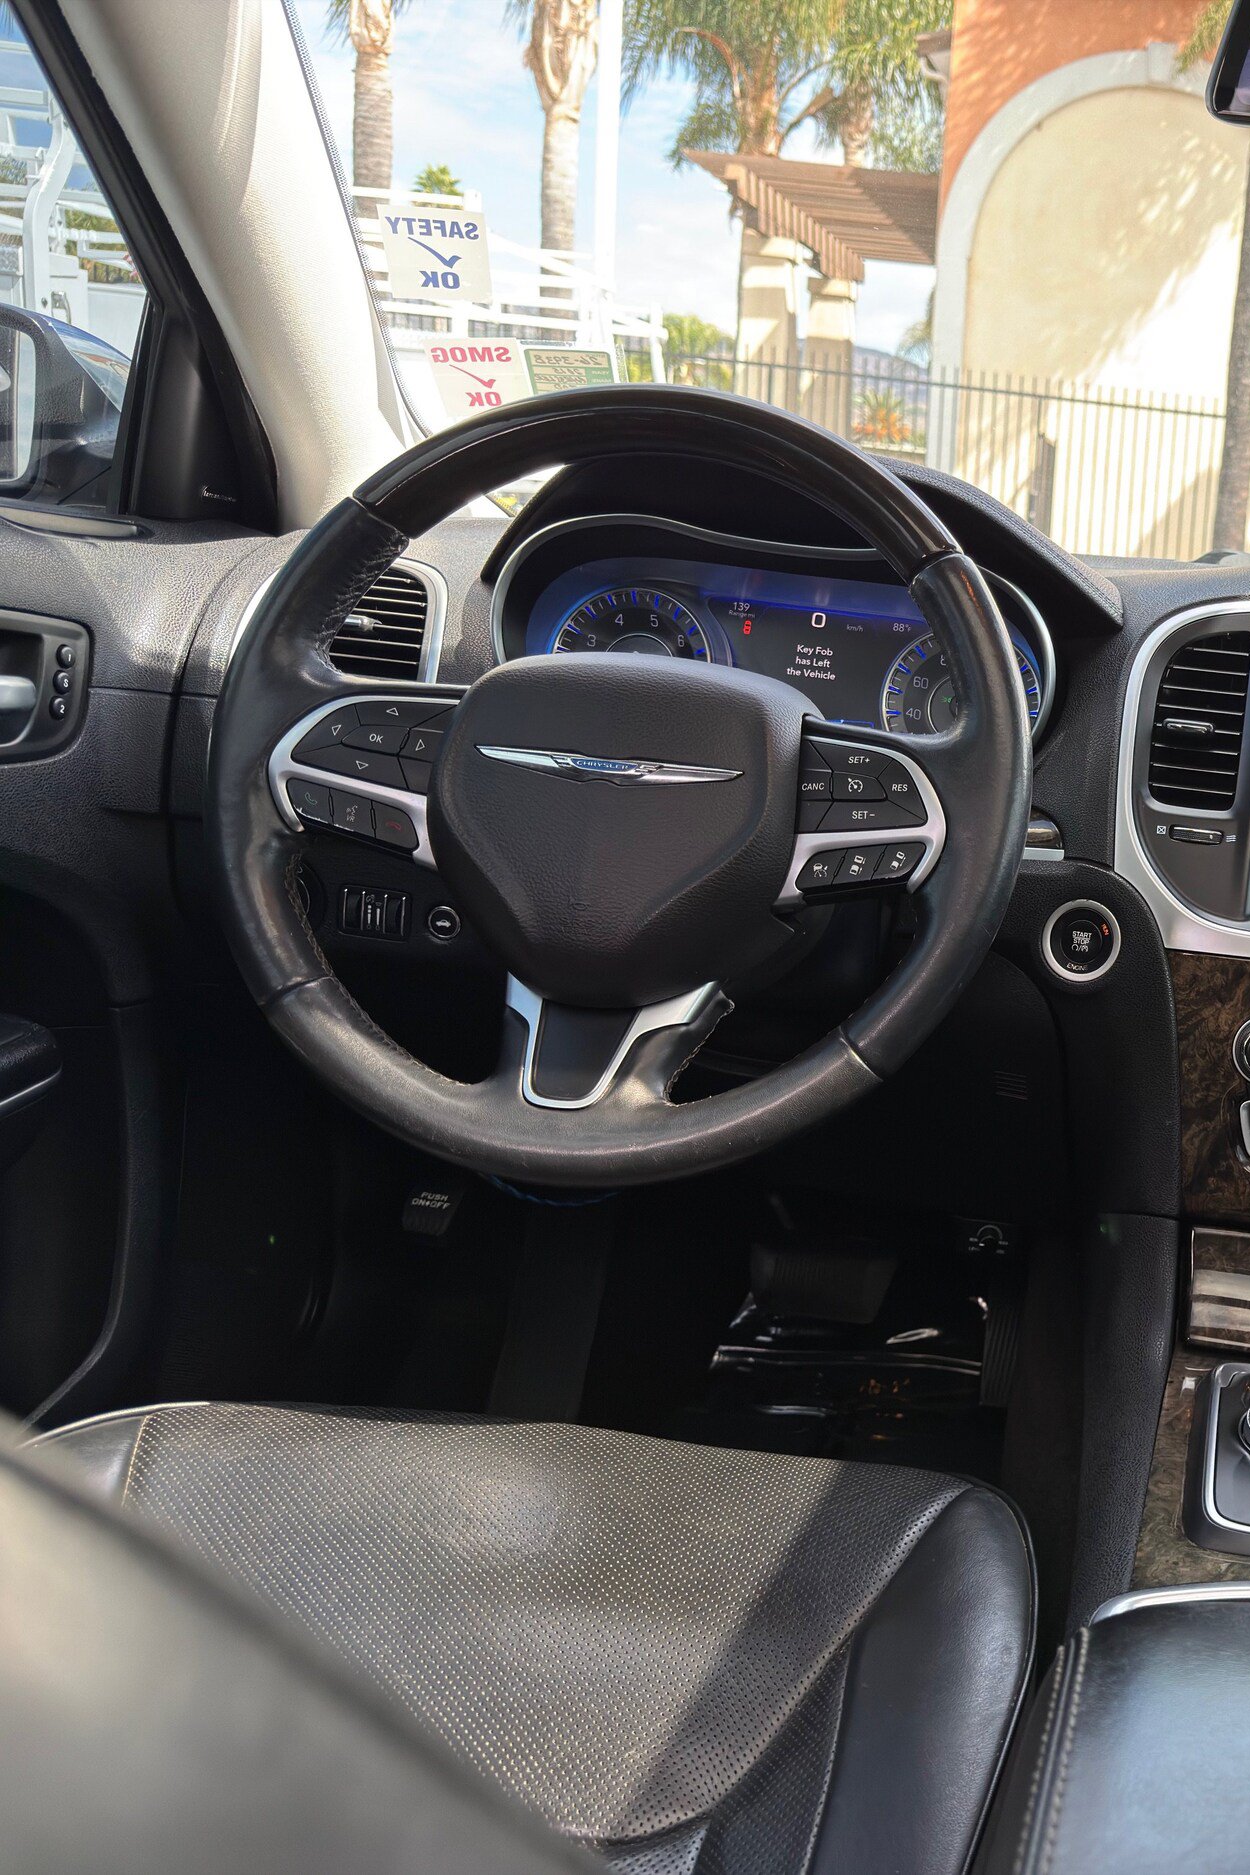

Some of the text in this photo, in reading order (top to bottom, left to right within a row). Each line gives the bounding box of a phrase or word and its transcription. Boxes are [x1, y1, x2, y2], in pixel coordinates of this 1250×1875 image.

[733, 602, 750, 611] 139
[614, 613, 624, 627] 4
[650, 614, 659, 628] 5
[811, 612, 826, 628] 0
[587, 634, 596, 647] 3
[677, 634, 685, 648] 6
[797, 644, 833, 656] Key Fob
[795, 656, 830, 668] has Left
[786, 667, 836, 680] the Vehicle
[63, 679, 69, 688] S
[913, 676, 929, 690] 60
[60, 704, 65, 713] 2
[905, 708, 922, 720] 40
[369, 733, 383, 744] OK
[576, 759, 629, 770] CHRYSLER
[801, 783, 825, 791] CANC
[891, 784, 908, 792] RES
[1072, 931, 1092, 939] START
[421, 1191, 449, 1201] PUSH
